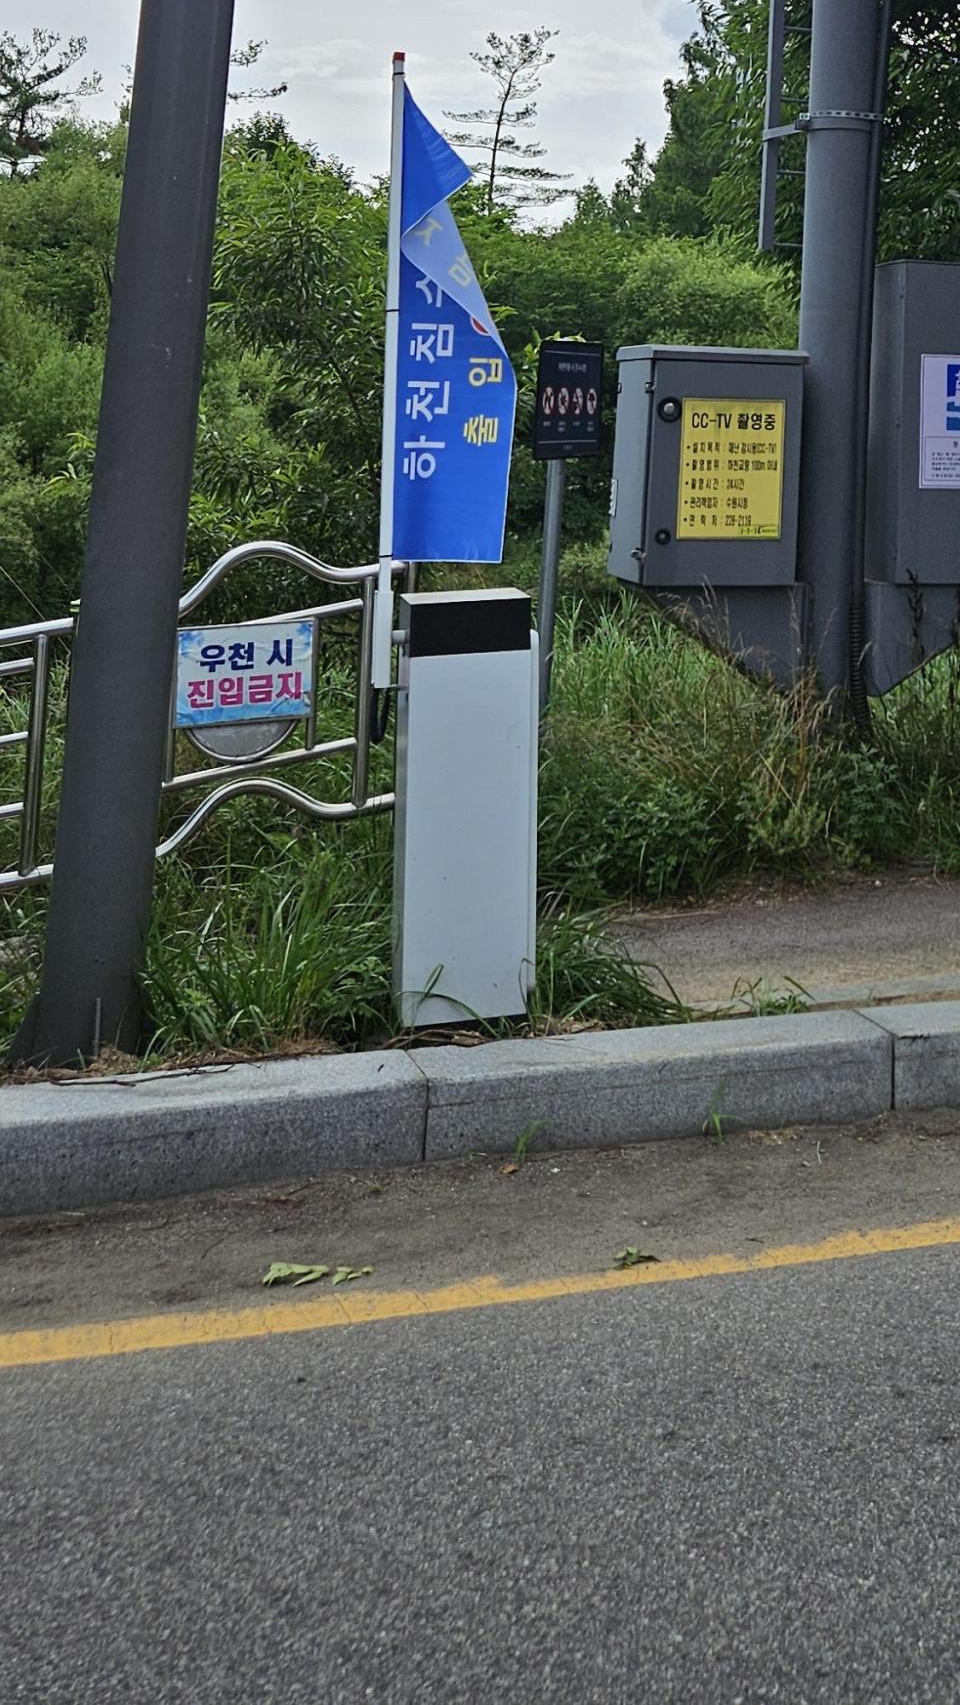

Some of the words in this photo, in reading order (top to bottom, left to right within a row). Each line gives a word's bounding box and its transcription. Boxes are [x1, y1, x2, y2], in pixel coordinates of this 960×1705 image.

[692, 412, 732, 429] CC-TV
[737, 413, 776, 431] 촬영중
[200, 642, 254, 672] 우천
[267, 639, 293, 667] 시
[187, 672, 302, 709] 진입금지
